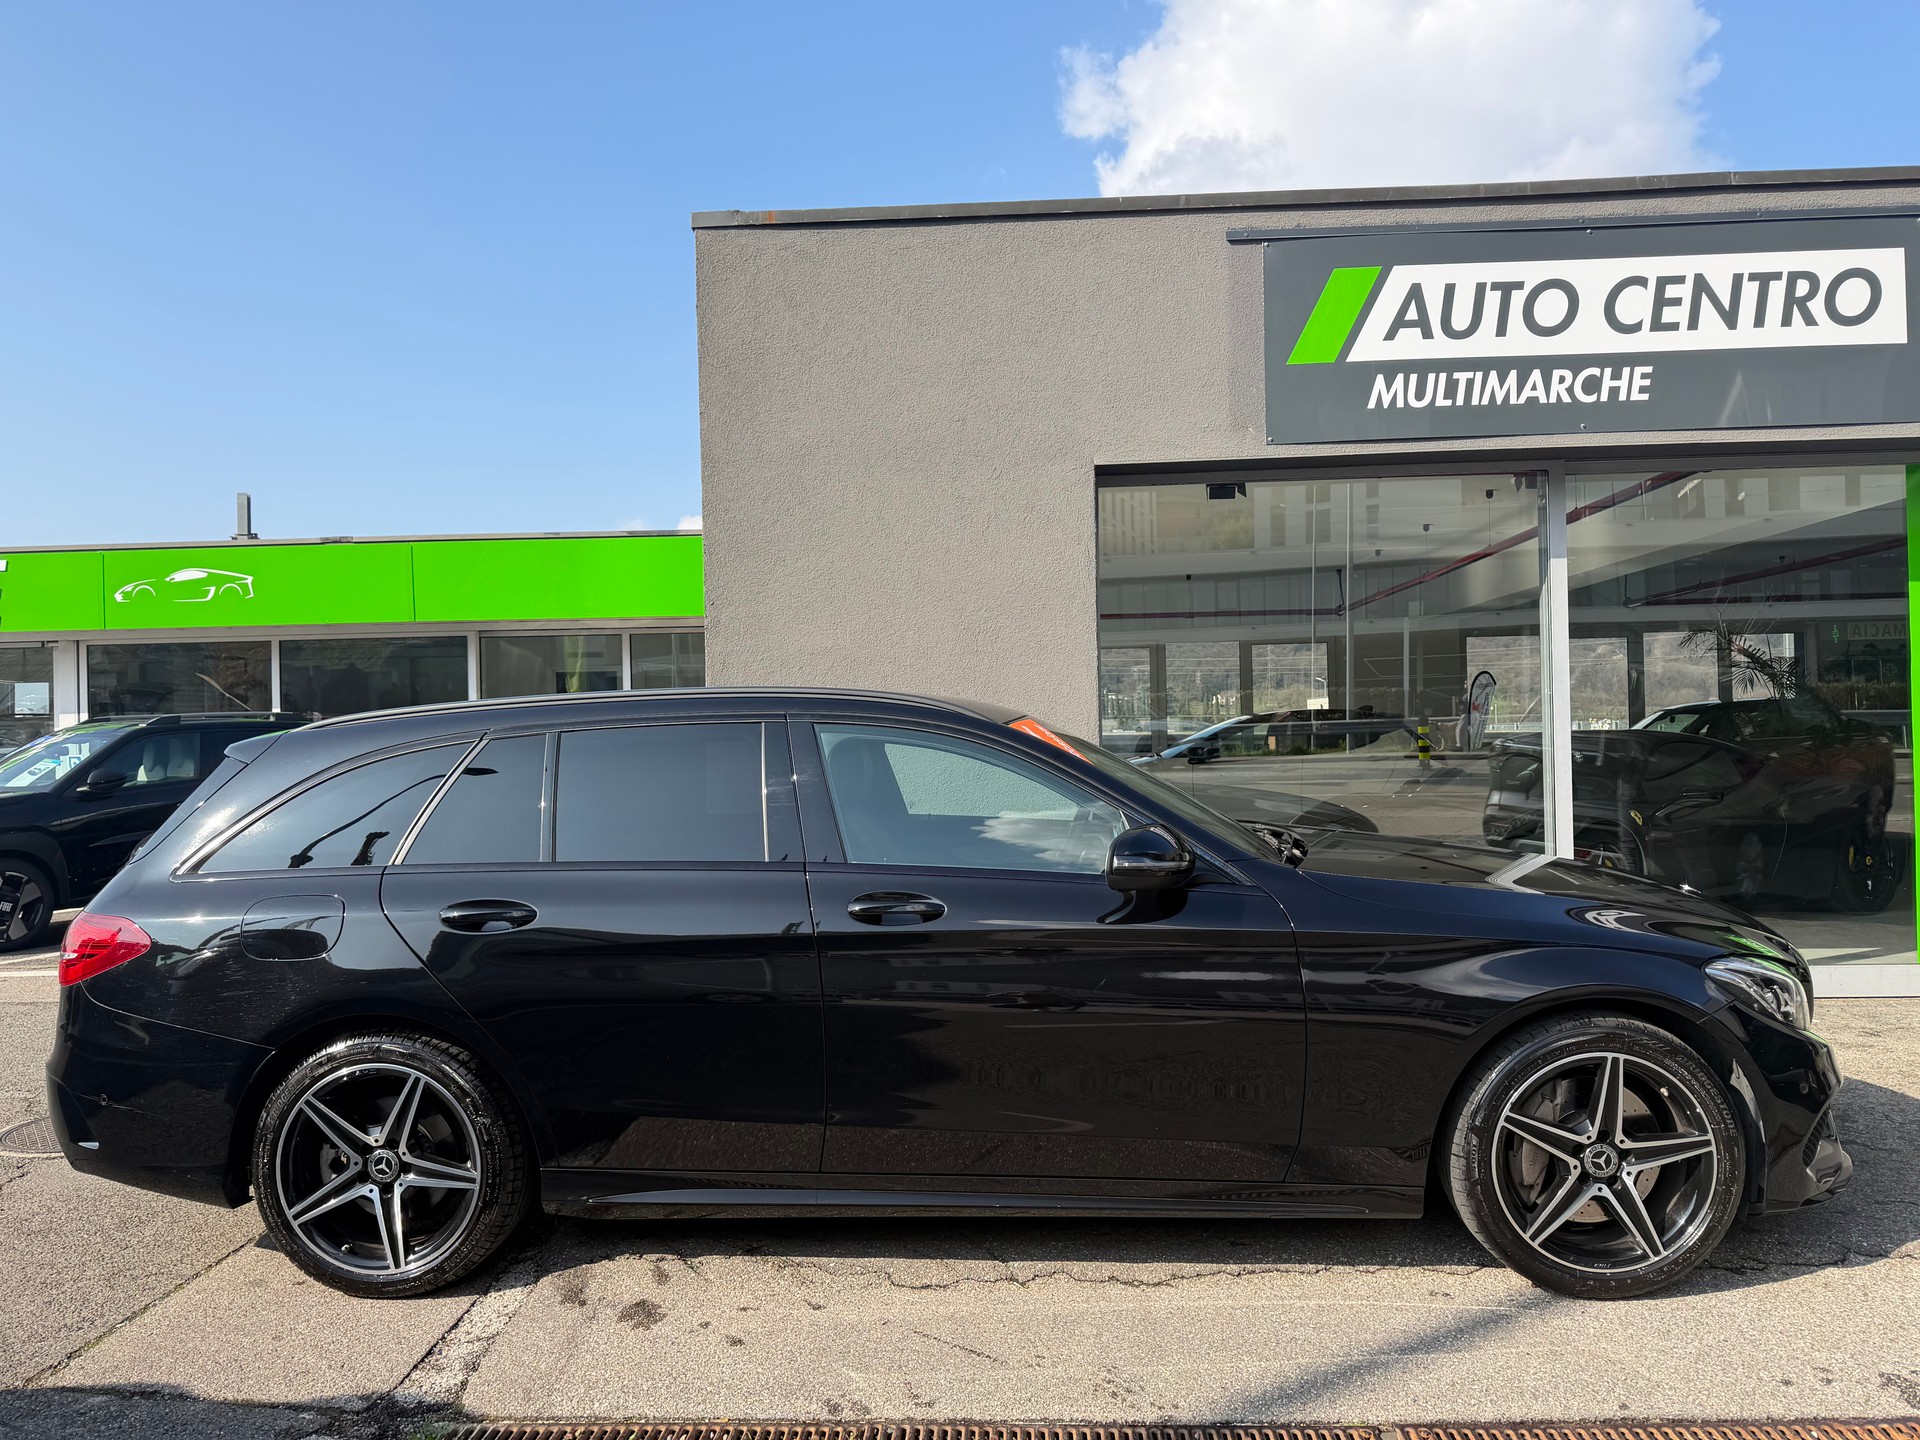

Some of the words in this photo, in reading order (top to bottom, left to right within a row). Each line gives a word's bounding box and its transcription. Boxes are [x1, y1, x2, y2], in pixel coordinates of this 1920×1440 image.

[1383, 278, 1579, 341] AUTO
[1603, 267, 1882, 335] CENTRO
[1367, 366, 1653, 409] MULTIMARCHE
[0, 901, 13, 912] FIAT
